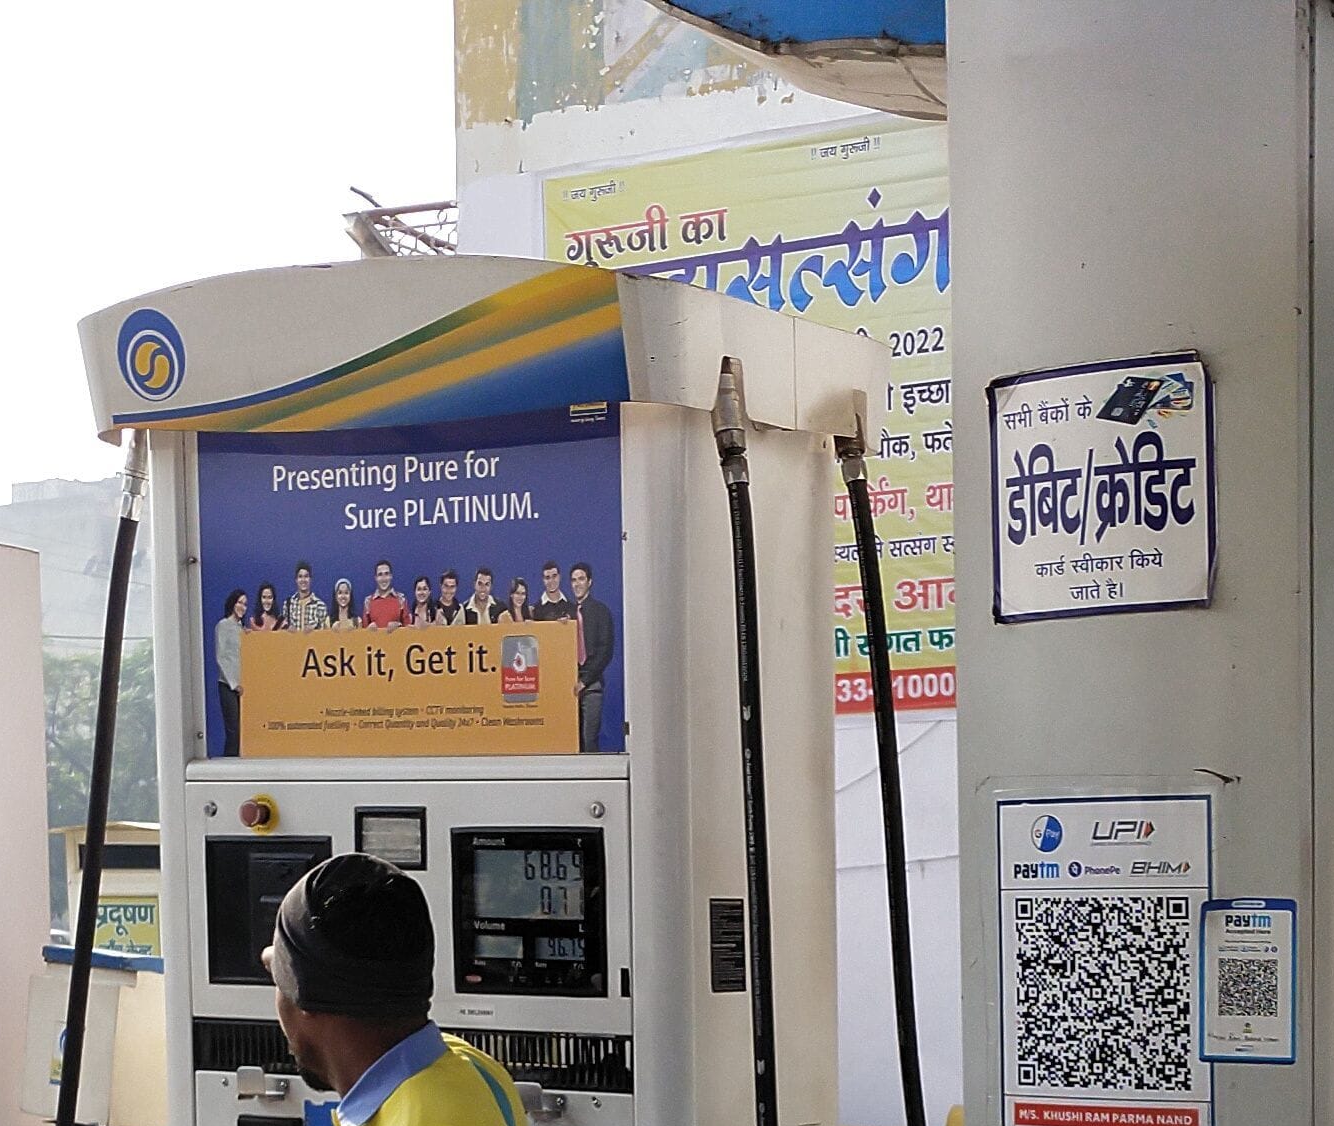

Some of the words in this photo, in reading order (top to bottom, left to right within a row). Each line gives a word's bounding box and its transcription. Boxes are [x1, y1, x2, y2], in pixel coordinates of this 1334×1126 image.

[679, 207, 729, 246] का
[889, 326, 945, 358] 2022
[1002, 402, 1034, 431] सभी
[1074, 394, 1094, 420] के
[272, 460, 397, 493] Presenting
[403, 456, 459, 484] Pure
[464, 450, 500, 480] for
[344, 502, 397, 531] Sure
[403, 491, 540, 527] PLATINUM.
[1034, 554, 1066, 578] कार्ड
[1069, 552, 1124, 575] स्वीकार
[1128, 547, 1164, 571] किये
[1069, 579, 1101, 601] जाते
[300, 647, 358, 679] Ask
[365, 645, 395, 683] it,
[405, 644, 458, 676] Get
[467, 642, 498, 675] it.
[472, 837, 506, 846] Amount
[1091, 820, 1144, 841] UPI
[1130, 861, 1183, 875] BHIM
[473, 920, 506, 931] Volume
[1042, 1110, 1083, 1122] KHUSHI
[1084, 1111, 1110, 1123] RAM
[1112, 1112, 1154, 1125] PARMA
[1156, 1114, 1193, 1126] NAND
